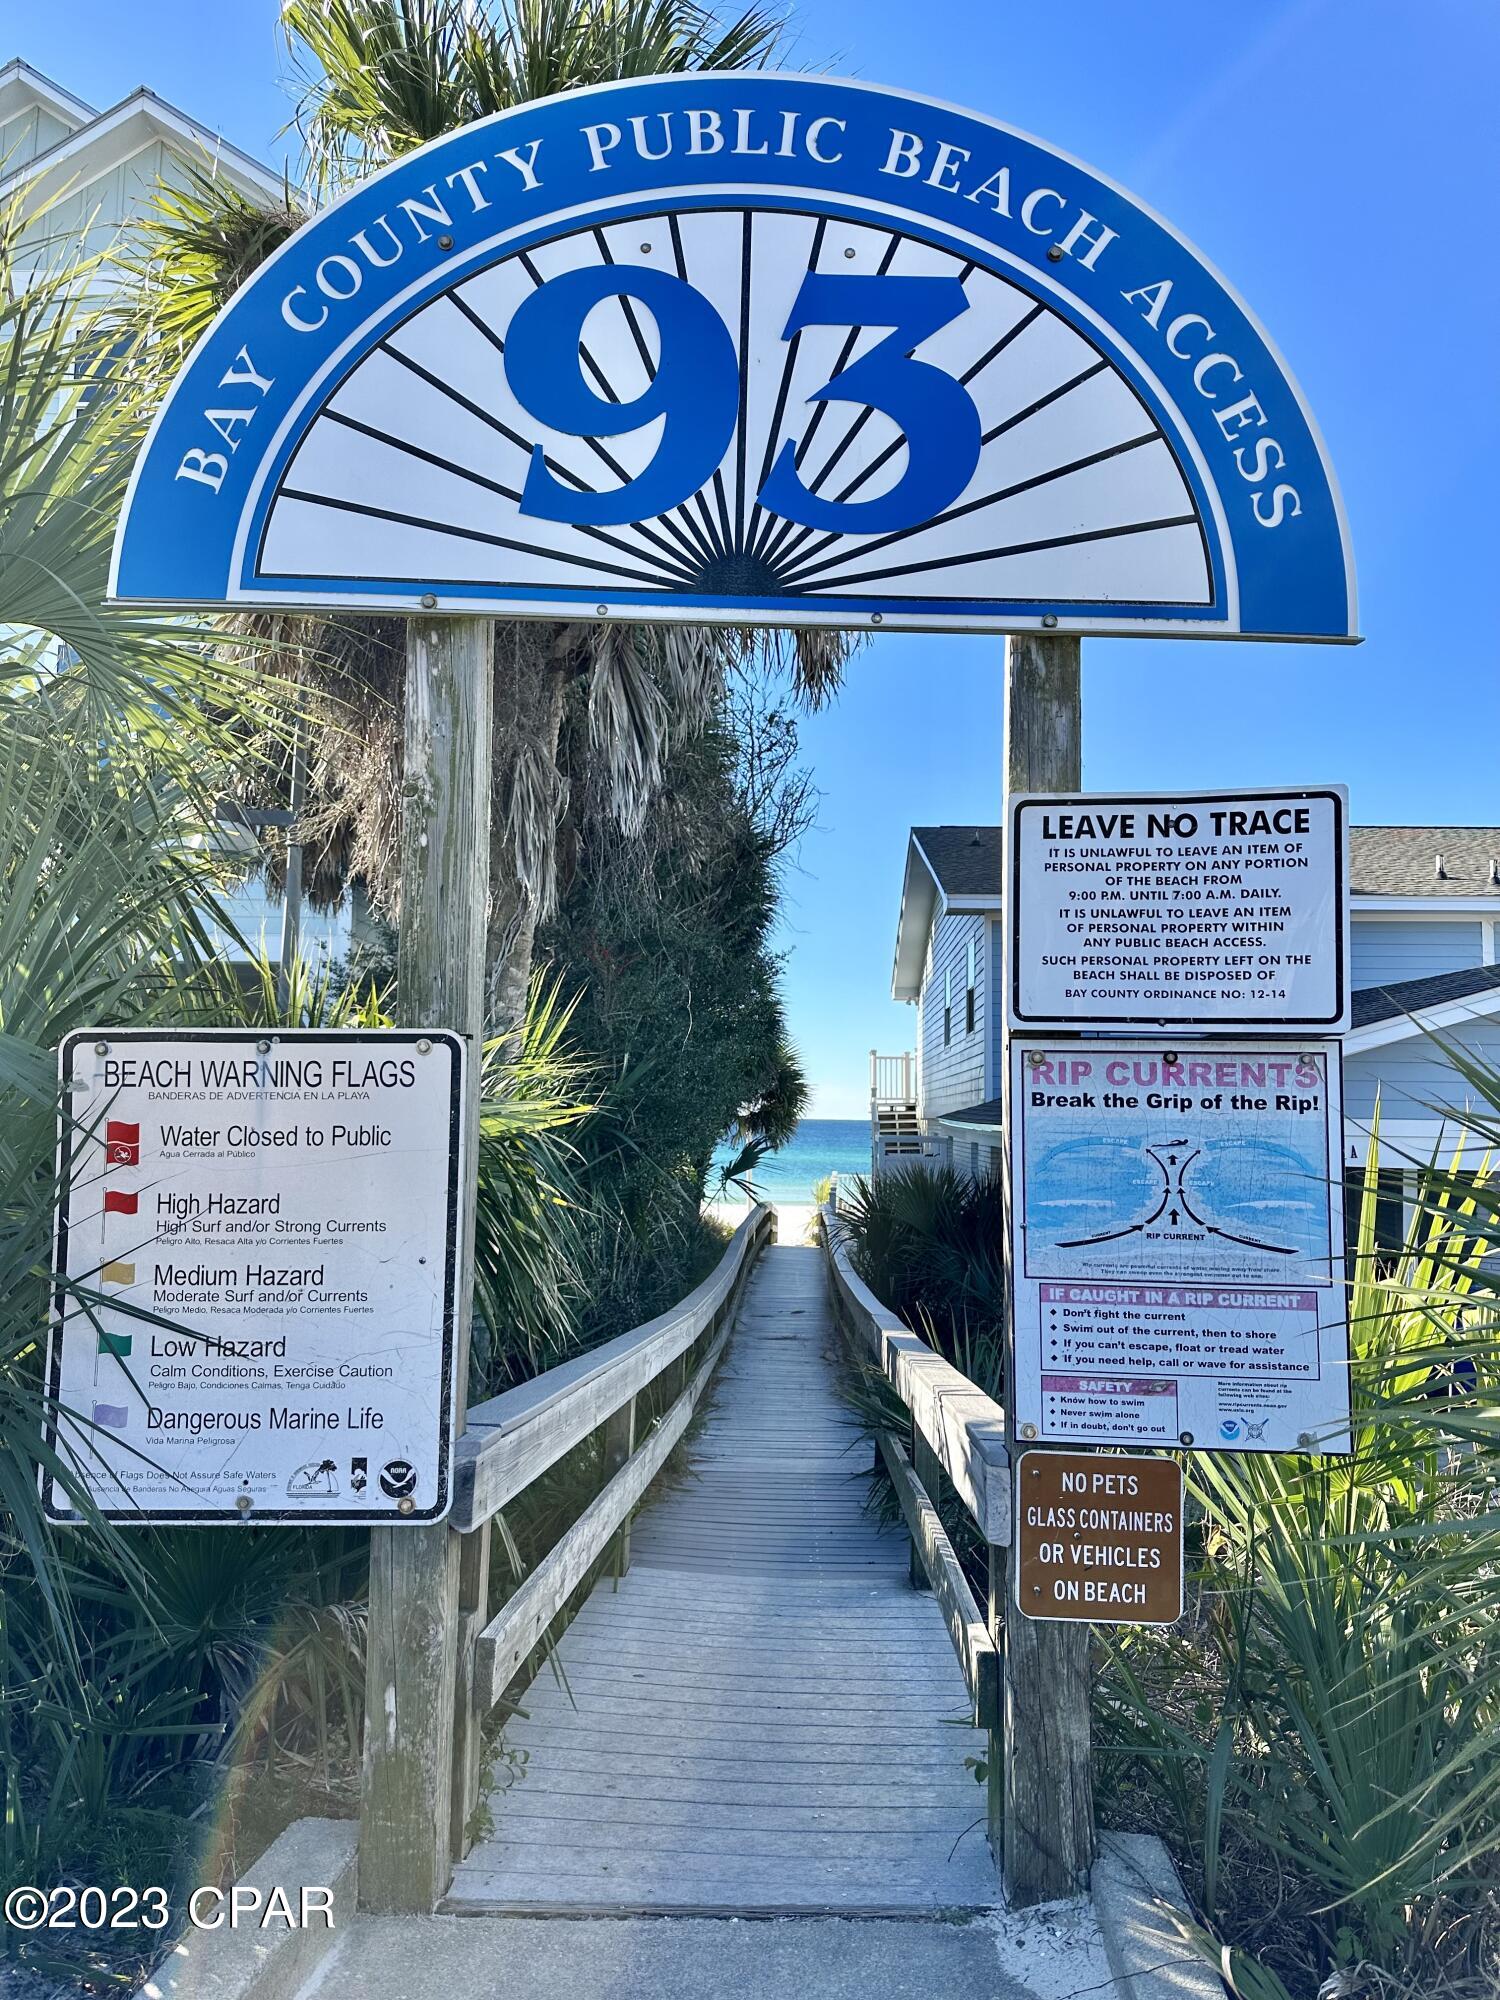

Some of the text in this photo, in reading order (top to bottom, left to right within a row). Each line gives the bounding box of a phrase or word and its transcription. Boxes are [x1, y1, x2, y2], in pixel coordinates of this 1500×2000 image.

[174, 108, 1302, 528] BAY COUNTY PUBLIC BEACH ACCESS
[503, 264, 982, 535] 93
[1042, 810, 1309, 840] LEAVE NO TRACE
[1049, 844, 1302, 857] IT IS UNLAWFUL TO LEAVE AN ITEM OF
[1044, 858, 1307, 872] PERSONAL PROPERTY ON ANY PORTION
[1105, 875, 1241, 885] OF THE BEACH FROM
[1068, 891, 1096, 900] 9:00
[1130, 890, 1168, 899] UNTIL
[1172, 890, 1200, 899] 7:00
[1240, 889, 1280, 898] DAILY.
[1060, 907, 1290, 918] IT IS UNLAWFUL TO LEAVE AN ITEM
[1067, 922, 1283, 932] OF PERSONAL PROPERTY WITHIN
[1083, 938, 1266, 947] ANY PUBLIC BEACH ACCESS.
[1042, 956, 1311, 964] SUCH PERSONAL PROPERTY LEFT ON THE
[1073, 971, 1274, 980] BEACH SHALL BE DISPOSED OF
[1143, 990, 1216, 998] ORDINANCE
[1221, 990, 1244, 998] NO:
[1250, 990, 1285, 998] 12-14
[104, 1060, 415, 1088] BEACH WARNING FLAGS
[1032, 1061, 1318, 1088] RIP CURRENTS
[148, 1092, 369, 1100] BANDERAS DE ADVERTENCIA EN LA PLAYA
[1031, 1092, 1320, 1114] Break the Grip of the Rip!
[160, 1126, 390, 1146] Water Closed to Public
[157, 1193, 280, 1218] High Hazard
[156, 1220, 386, 1235] High Surf and/or Strong Currents
[156, 1238, 182, 1247] Peligro
[255, 1238, 267, 1247] y/o
[154, 1265, 323, 1285] Medium Hazard
[153, 1290, 367, 1302] Moderate Surf and/or Currents
[1050, 1288, 1300, 1308] IF CAUGHT IN A RIP CURRENT
[1063, 1324, 1276, 1338] Swim out of the current, then to shore
[151, 1336, 286, 1357] Low Hazard
[1075, 1342, 1094, 1350] you
[1098, 1341, 1124, 1349] can't
[1128, 1343, 1171, 1352] escape,
[1175, 1343, 1200, 1352] float
[1218, 1345, 1248, 1353] tread
[1252, 1346, 1284, 1354] water
[150, 1365, 392, 1379] Calm Conditions, Exercise Caution
[1079, 1380, 1132, 1392] SAFETY
[147, 1408, 383, 1435] Dangerous Marine Life
[197, 1437, 235, 1446] Peligrosa
[1062, 1472, 1138, 1496] NO PETS
[1028, 1506, 1173, 1533] GLASS CONTAINERS
[1040, 1543, 1160, 1568] OR VEHICLES
[1054, 1580, 1146, 1604] ON BEACH
